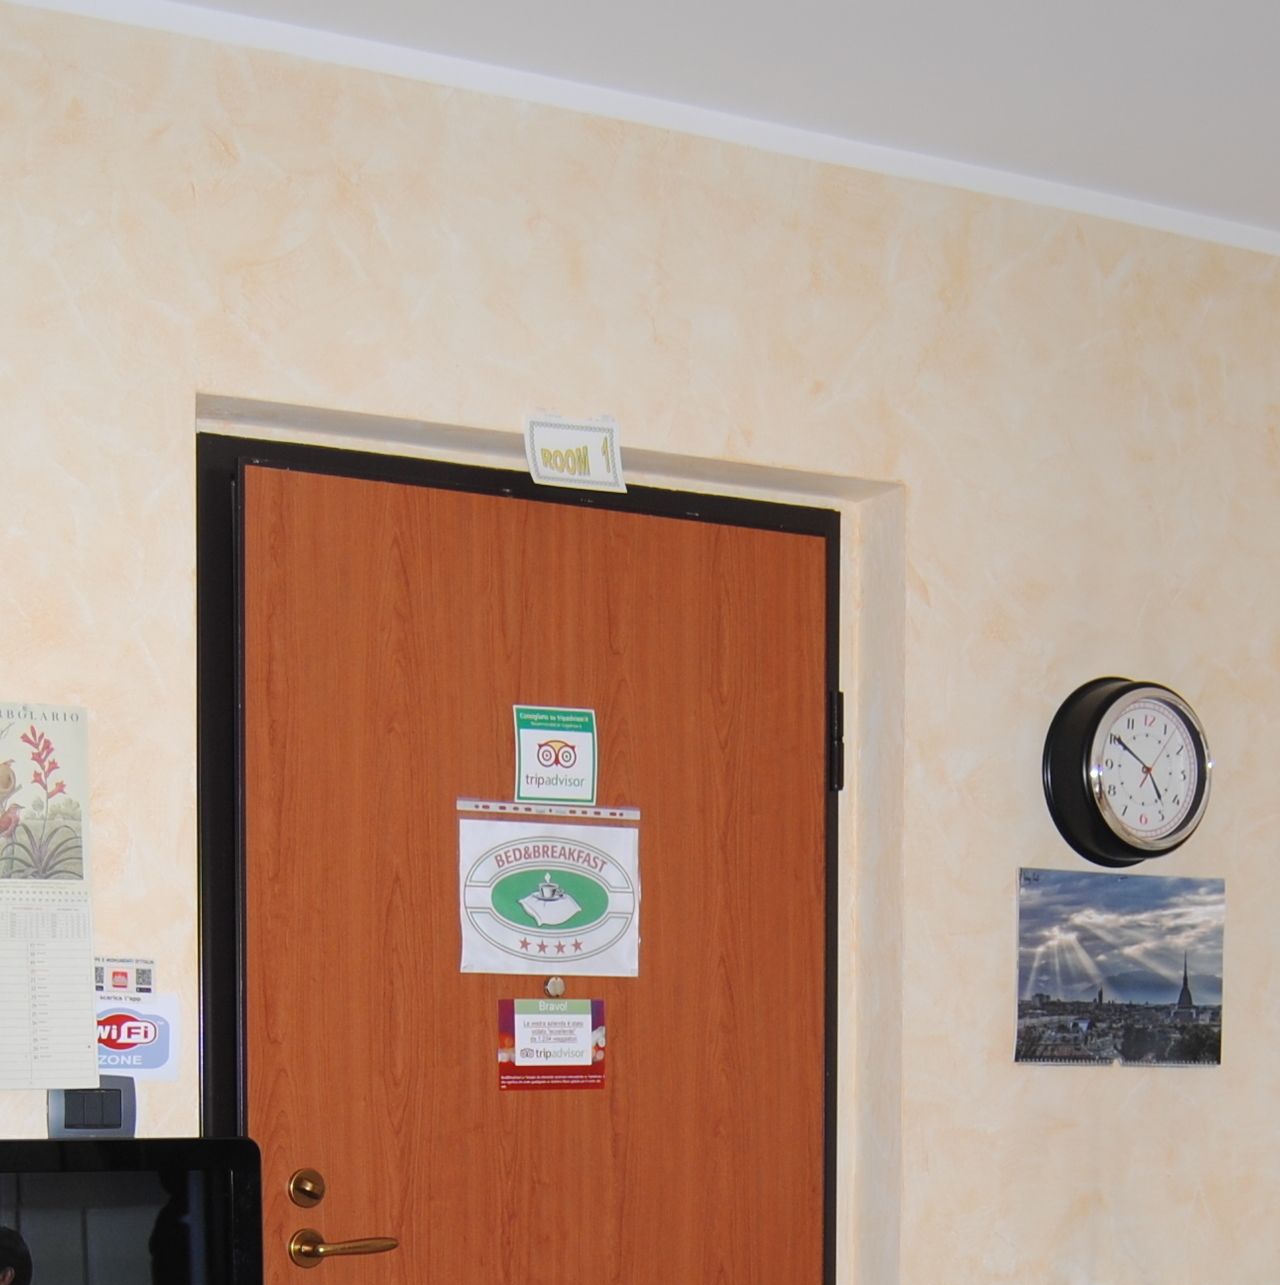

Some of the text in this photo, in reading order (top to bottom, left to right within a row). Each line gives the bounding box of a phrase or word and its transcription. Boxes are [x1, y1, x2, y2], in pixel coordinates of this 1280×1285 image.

[541, 435, 611, 476] ROOM 1
[526, 772, 585, 788] tripadvisor
[494, 844, 608, 873] BED&BREAKFAST
[99, 1055, 143, 1065] ZONE
[536, 1047, 584, 1060] tripadvisor
